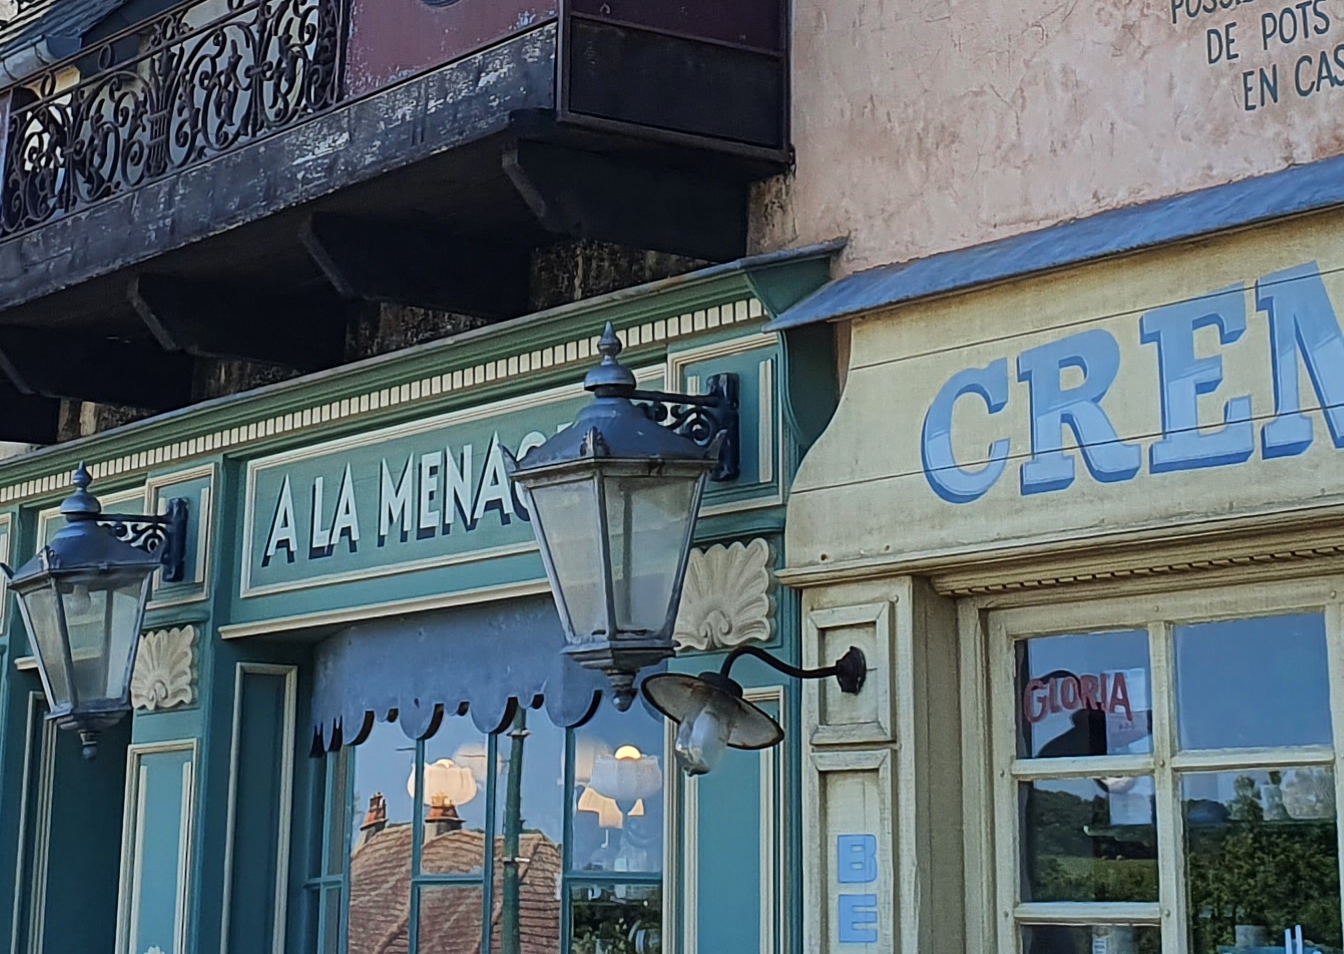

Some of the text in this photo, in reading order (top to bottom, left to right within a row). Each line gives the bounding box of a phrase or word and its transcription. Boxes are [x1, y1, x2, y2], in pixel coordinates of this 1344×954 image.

[1206, 21, 1239, 64] DE
[1242, 64, 1279, 111] EN
[262, 473, 297, 567] A
[309, 463, 360, 559] LA
[1024, 672, 1133, 723] GLORIA
